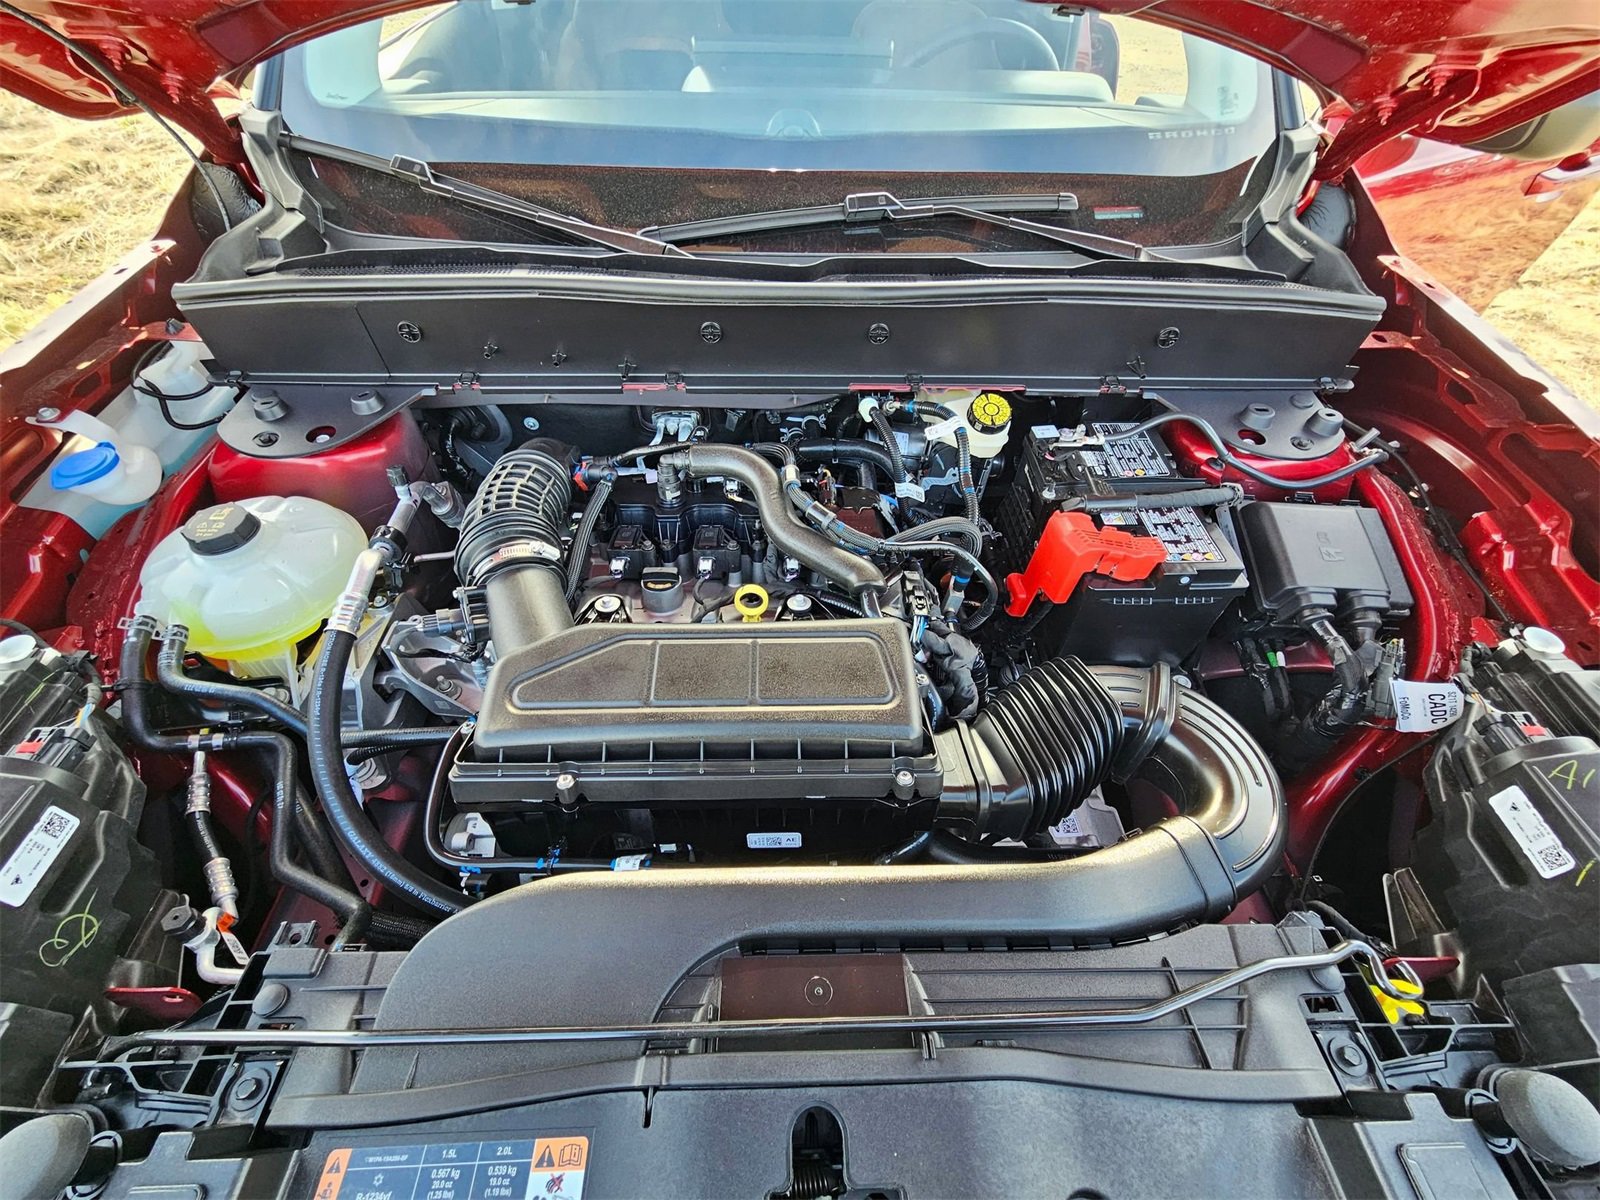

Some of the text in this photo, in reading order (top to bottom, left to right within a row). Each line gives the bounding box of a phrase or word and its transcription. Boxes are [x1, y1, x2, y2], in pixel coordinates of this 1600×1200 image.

[1399, 696, 1411, 720] FoMoCo
[1428, 693, 1447, 724] CADC
[347, 830, 375, 858] GALAXY
[442, 1149, 457, 1158] 1.5L
[496, 1146, 512, 1155] 2.0L
[431, 1168, 460, 1179] 0.567 kg
[488, 1165, 517, 1176] 0.539 kg
